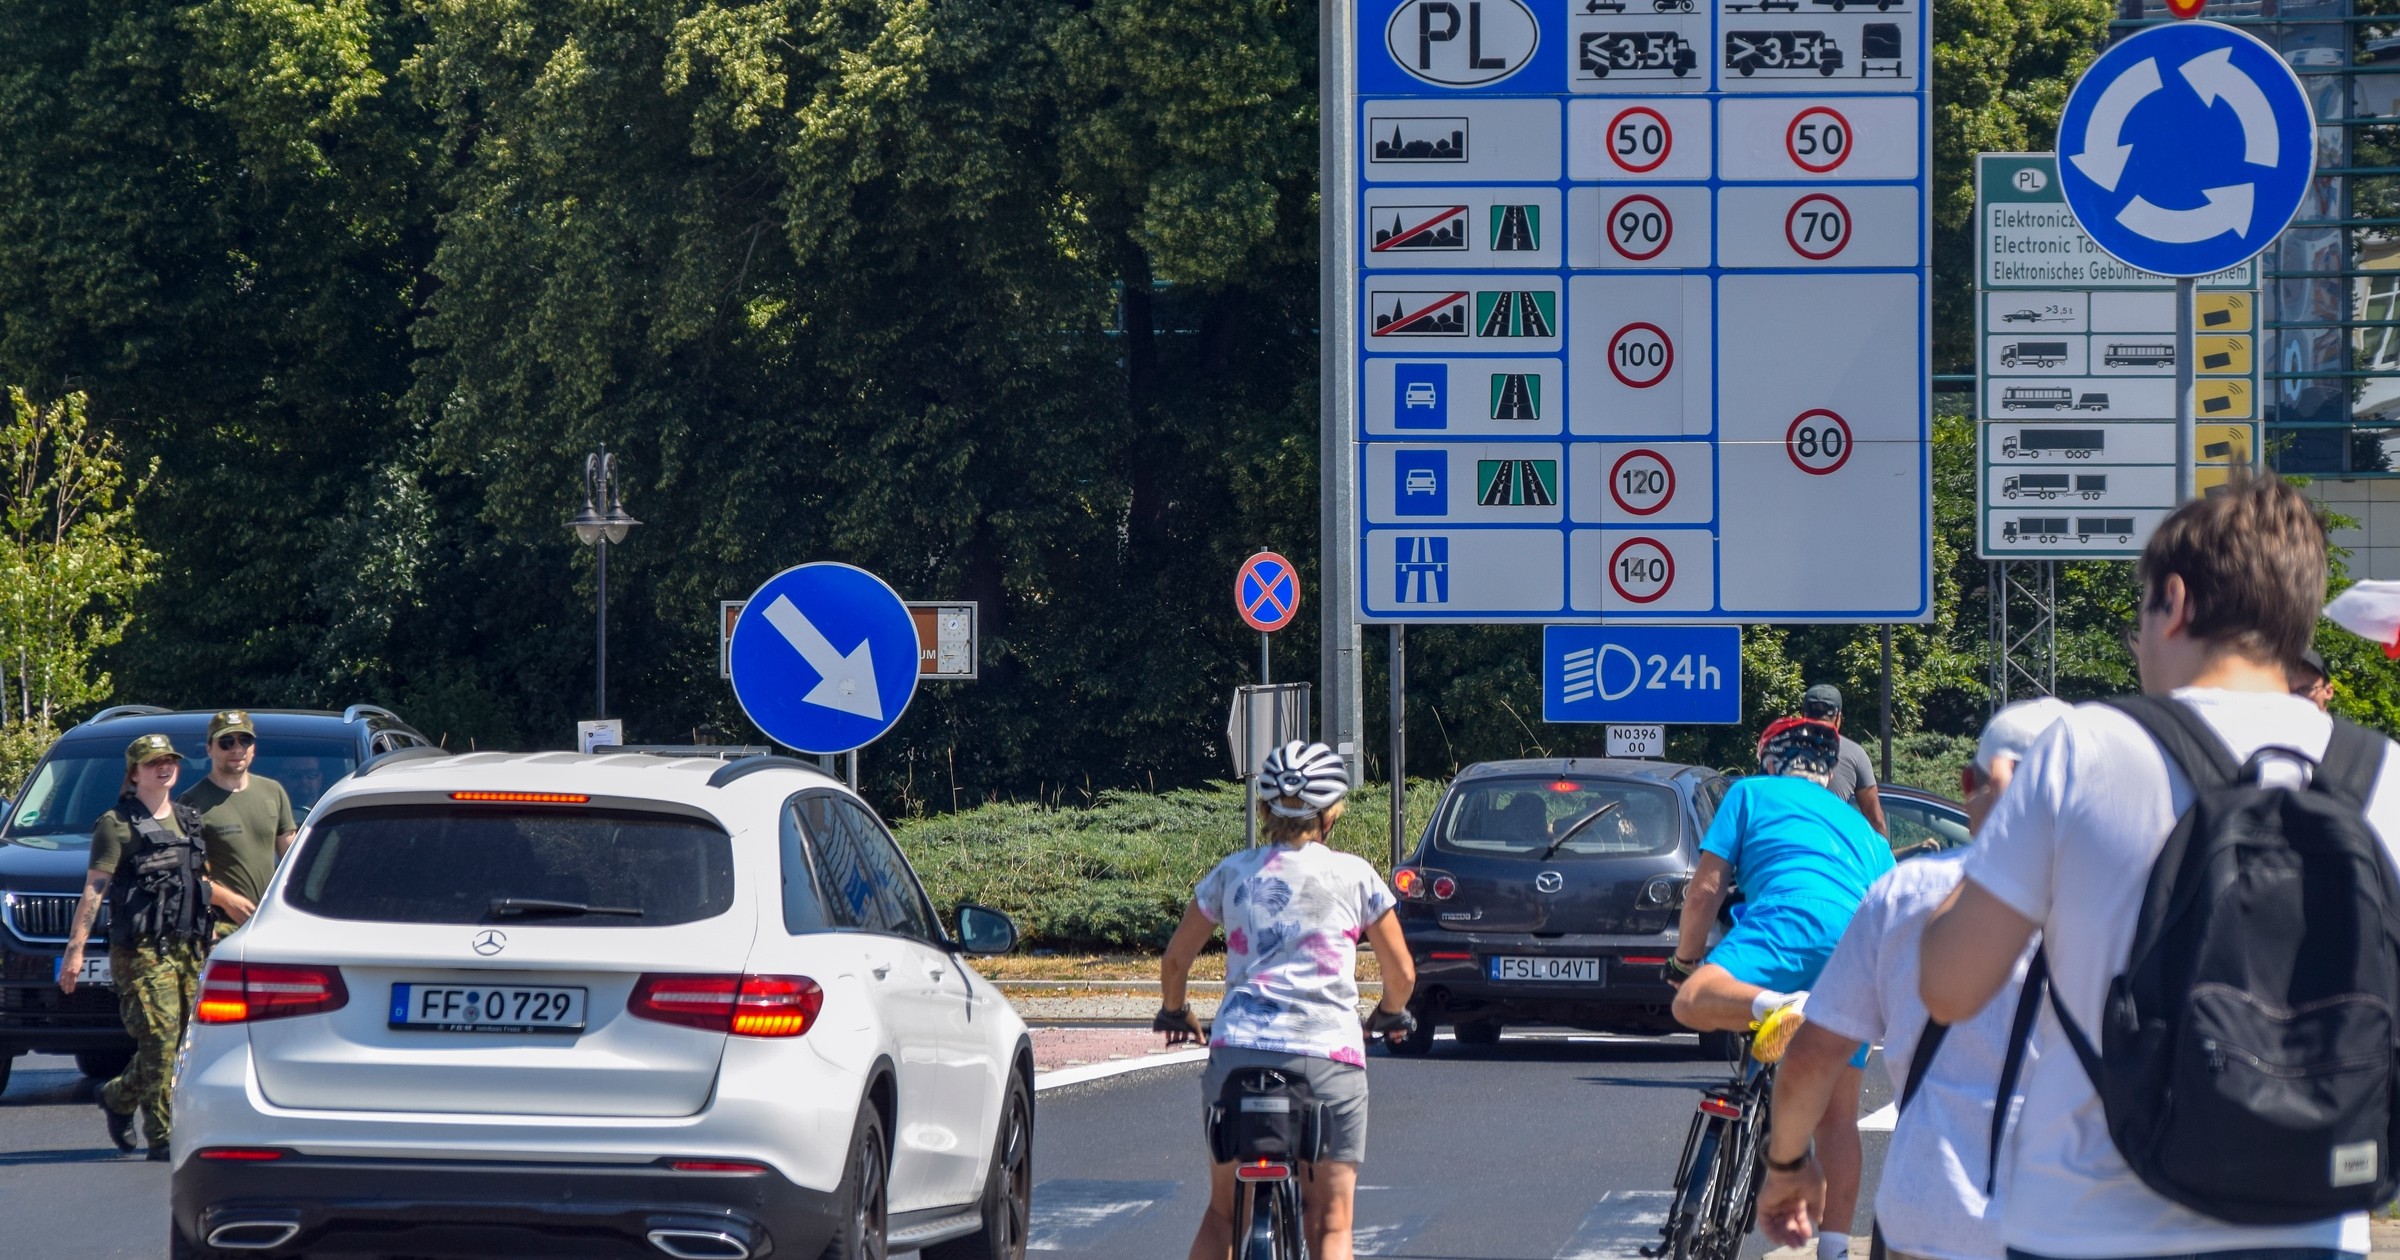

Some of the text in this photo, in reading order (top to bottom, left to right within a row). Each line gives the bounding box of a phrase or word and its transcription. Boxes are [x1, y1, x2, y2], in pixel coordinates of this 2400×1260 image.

[1419, 1, 1506, 70] PL
[1618, 125, 1663, 155] 50
[1797, 124, 1843, 155] 50
[2019, 172, 2040, 188] PL
[1619, 211, 1663, 244] 90
[1800, 211, 1842, 243] 70
[1994, 235, 2071, 254] Electronic
[1994, 261, 2085, 280] Elektronisches
[1618, 341, 1664, 367] 100
[1797, 426, 1842, 458] 80
[1622, 469, 1665, 495] 120
[1619, 556, 1665, 583] 140
[1646, 654, 1721, 690] 24h
[1613, 728, 1657, 740] N0396
[1503, 959, 1542, 978] FSL
[1549, 959, 1596, 979] 04VT
[421, 990, 464, 1019] FF
[512, 991, 571, 1022] 729
